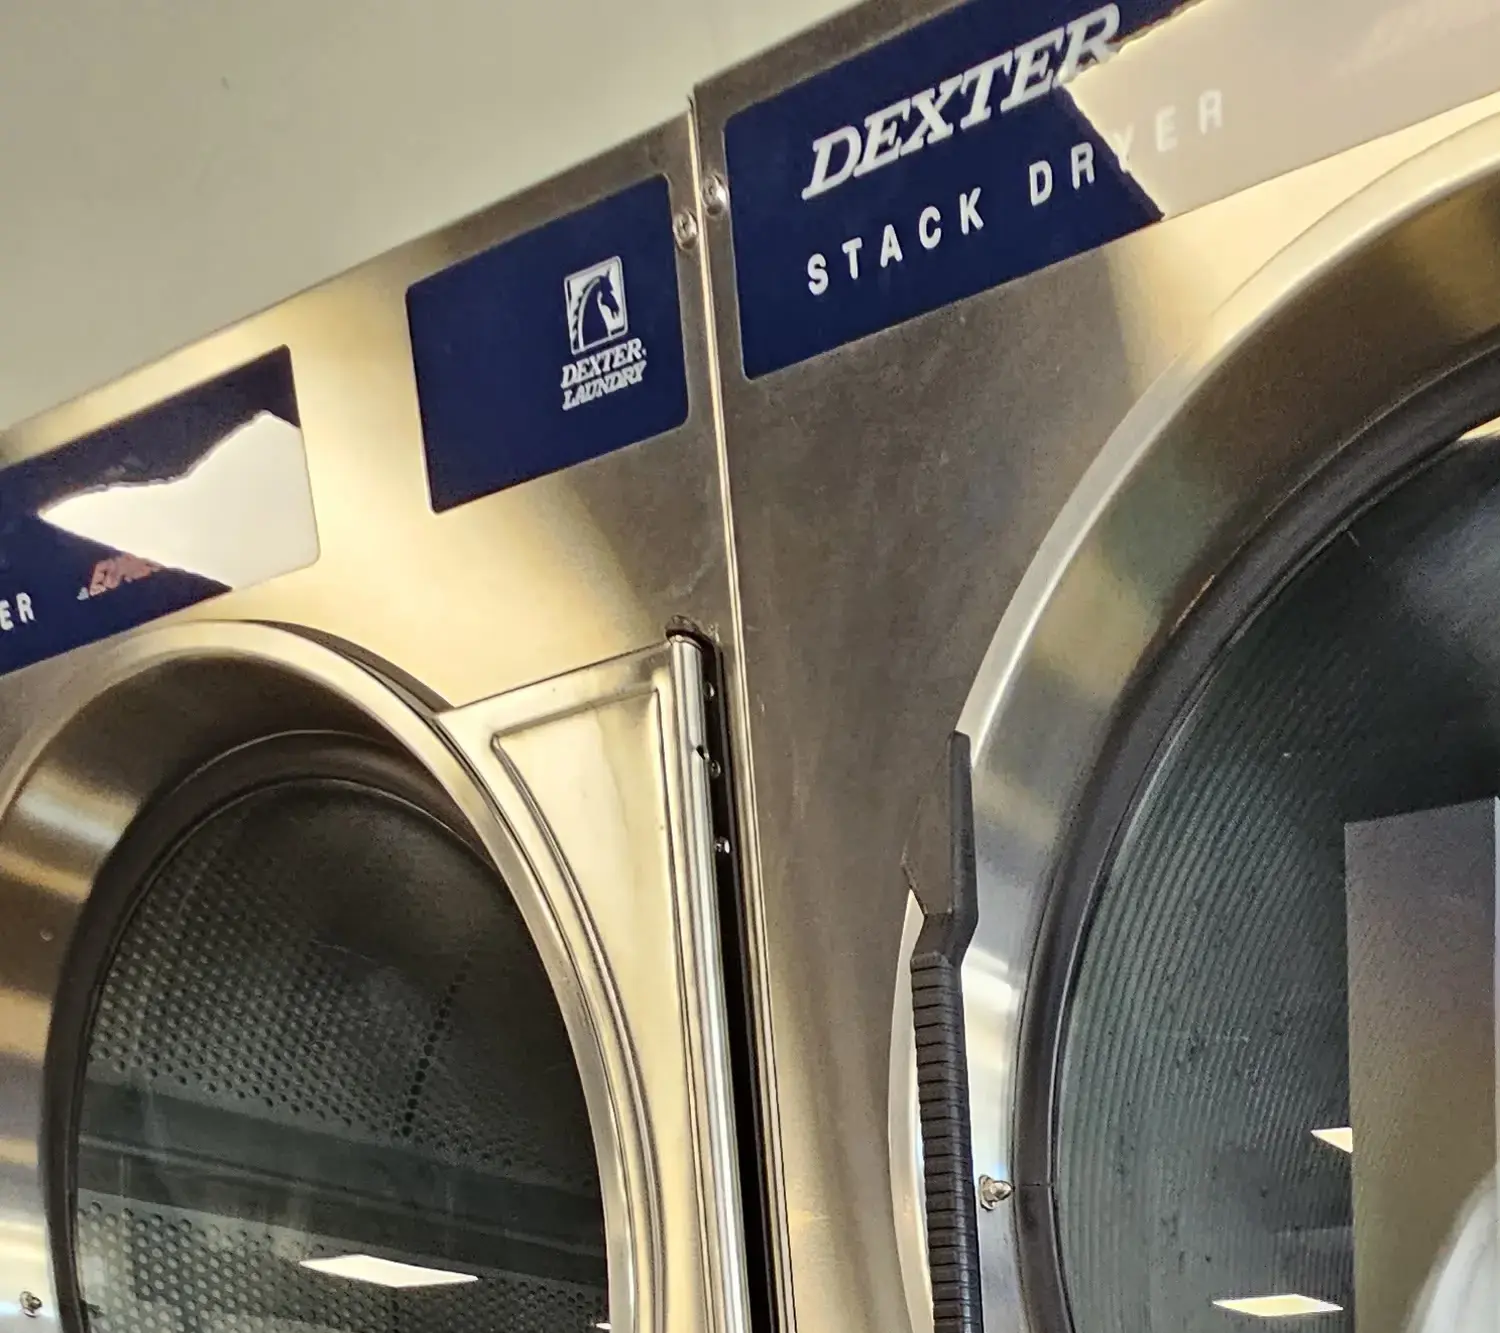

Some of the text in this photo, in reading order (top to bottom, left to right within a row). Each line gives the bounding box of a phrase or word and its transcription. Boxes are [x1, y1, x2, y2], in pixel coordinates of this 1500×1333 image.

[801, 5, 1121, 199] DEXTER
[806, 89, 1224, 296] STACK DRYER
[561, 338, 643, 389] DEXTER
[562, 360, 647, 411] LAUNDRY
